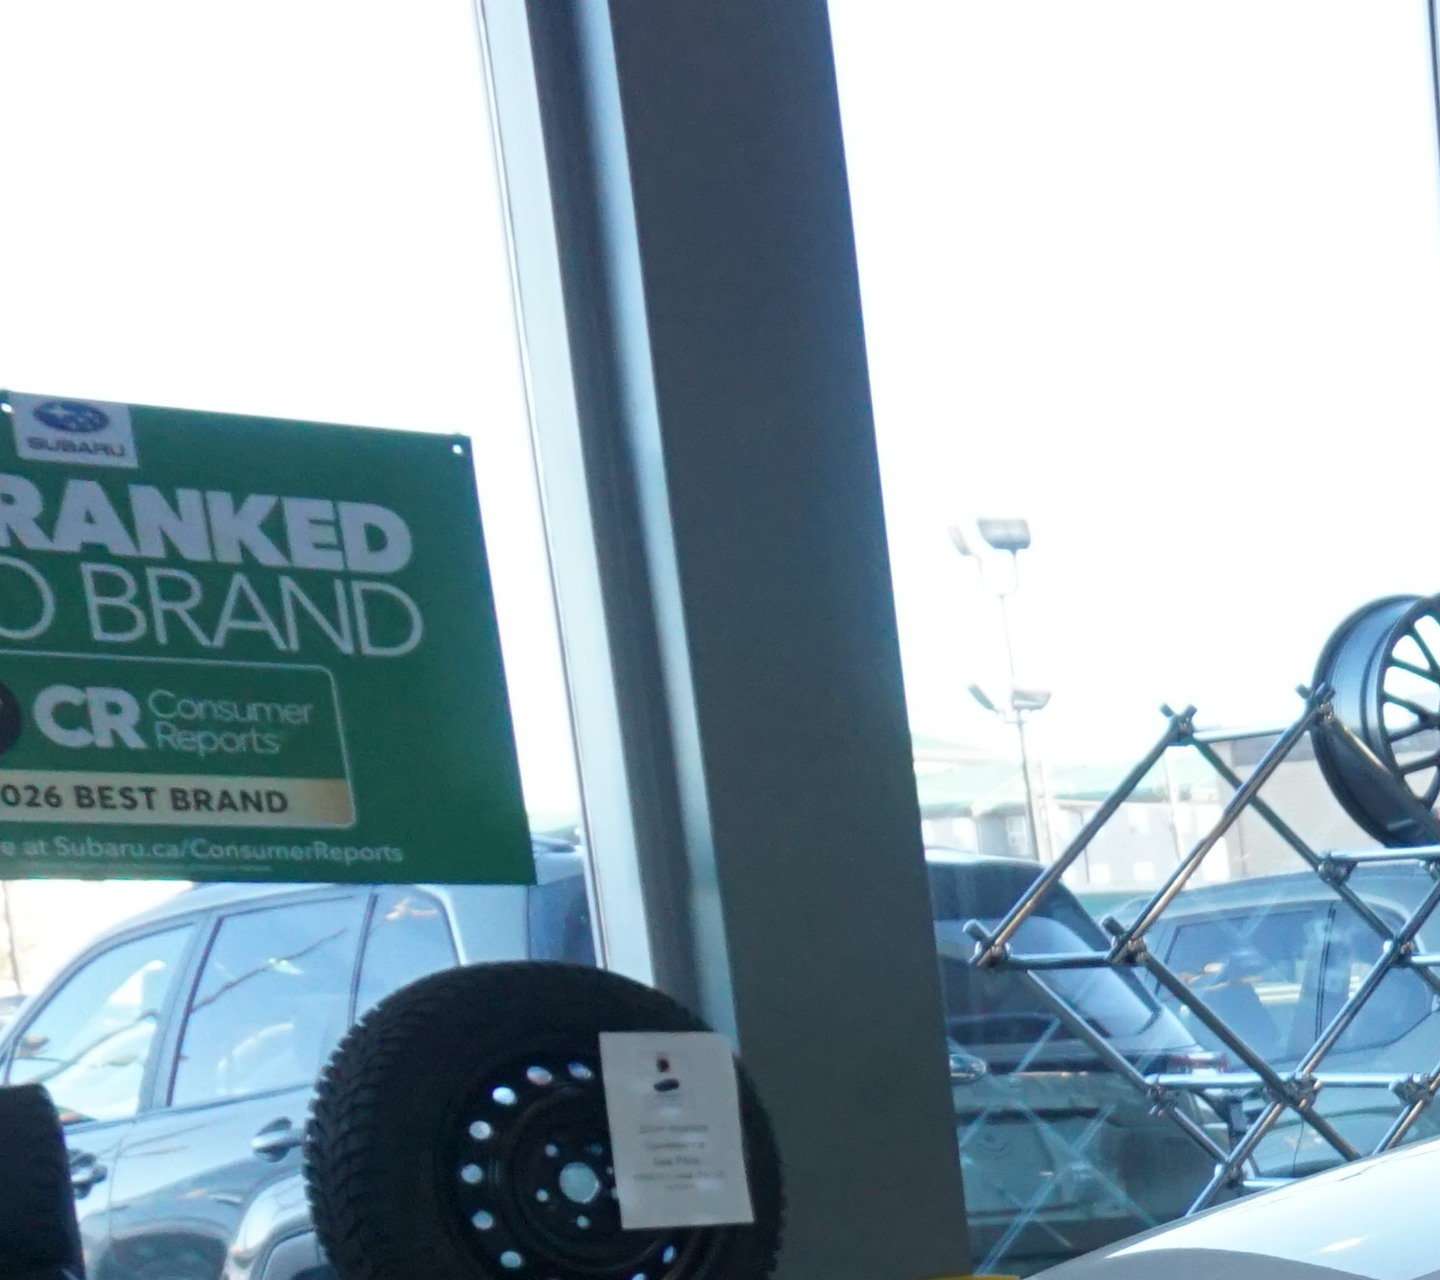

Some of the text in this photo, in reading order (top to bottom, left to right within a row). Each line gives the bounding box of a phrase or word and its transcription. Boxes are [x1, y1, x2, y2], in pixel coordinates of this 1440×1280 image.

[26, 436, 125, 457] SUBARU
[0, 473, 413, 573] RANKED
[81, 562, 423, 656] BRAND
[34, 684, 314, 748] CR Consumer
[154, 721, 281, 759] Reports
[73, 785, 157, 811] BEST
[168, 787, 288, 813] BRAND
[22, 838, 46, 857] at
